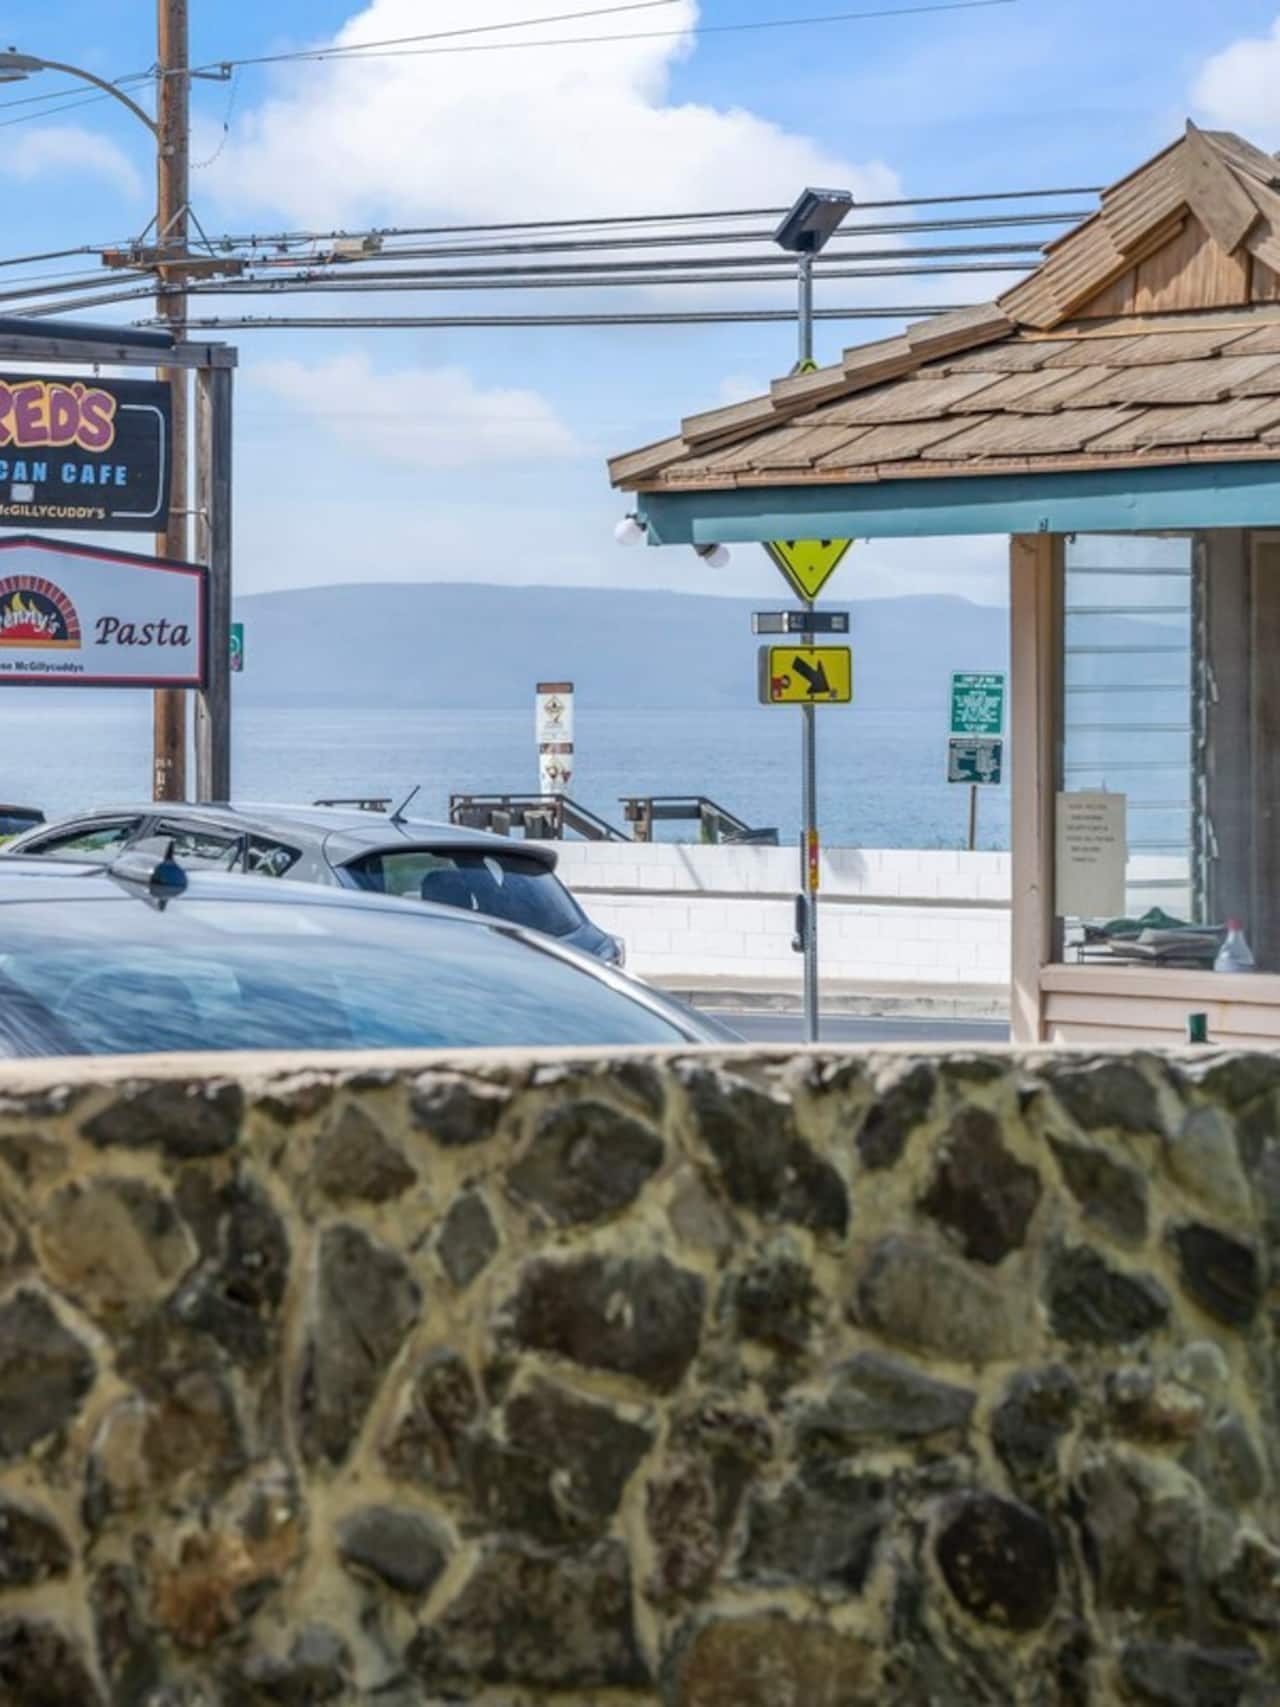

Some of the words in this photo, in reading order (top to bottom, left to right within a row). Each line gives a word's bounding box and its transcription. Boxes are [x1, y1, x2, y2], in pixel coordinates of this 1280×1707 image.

[61, 463, 128, 485] CAFE
[95, 616, 191, 647] Pasta
[14, 661, 84, 672] McGillycuddys
